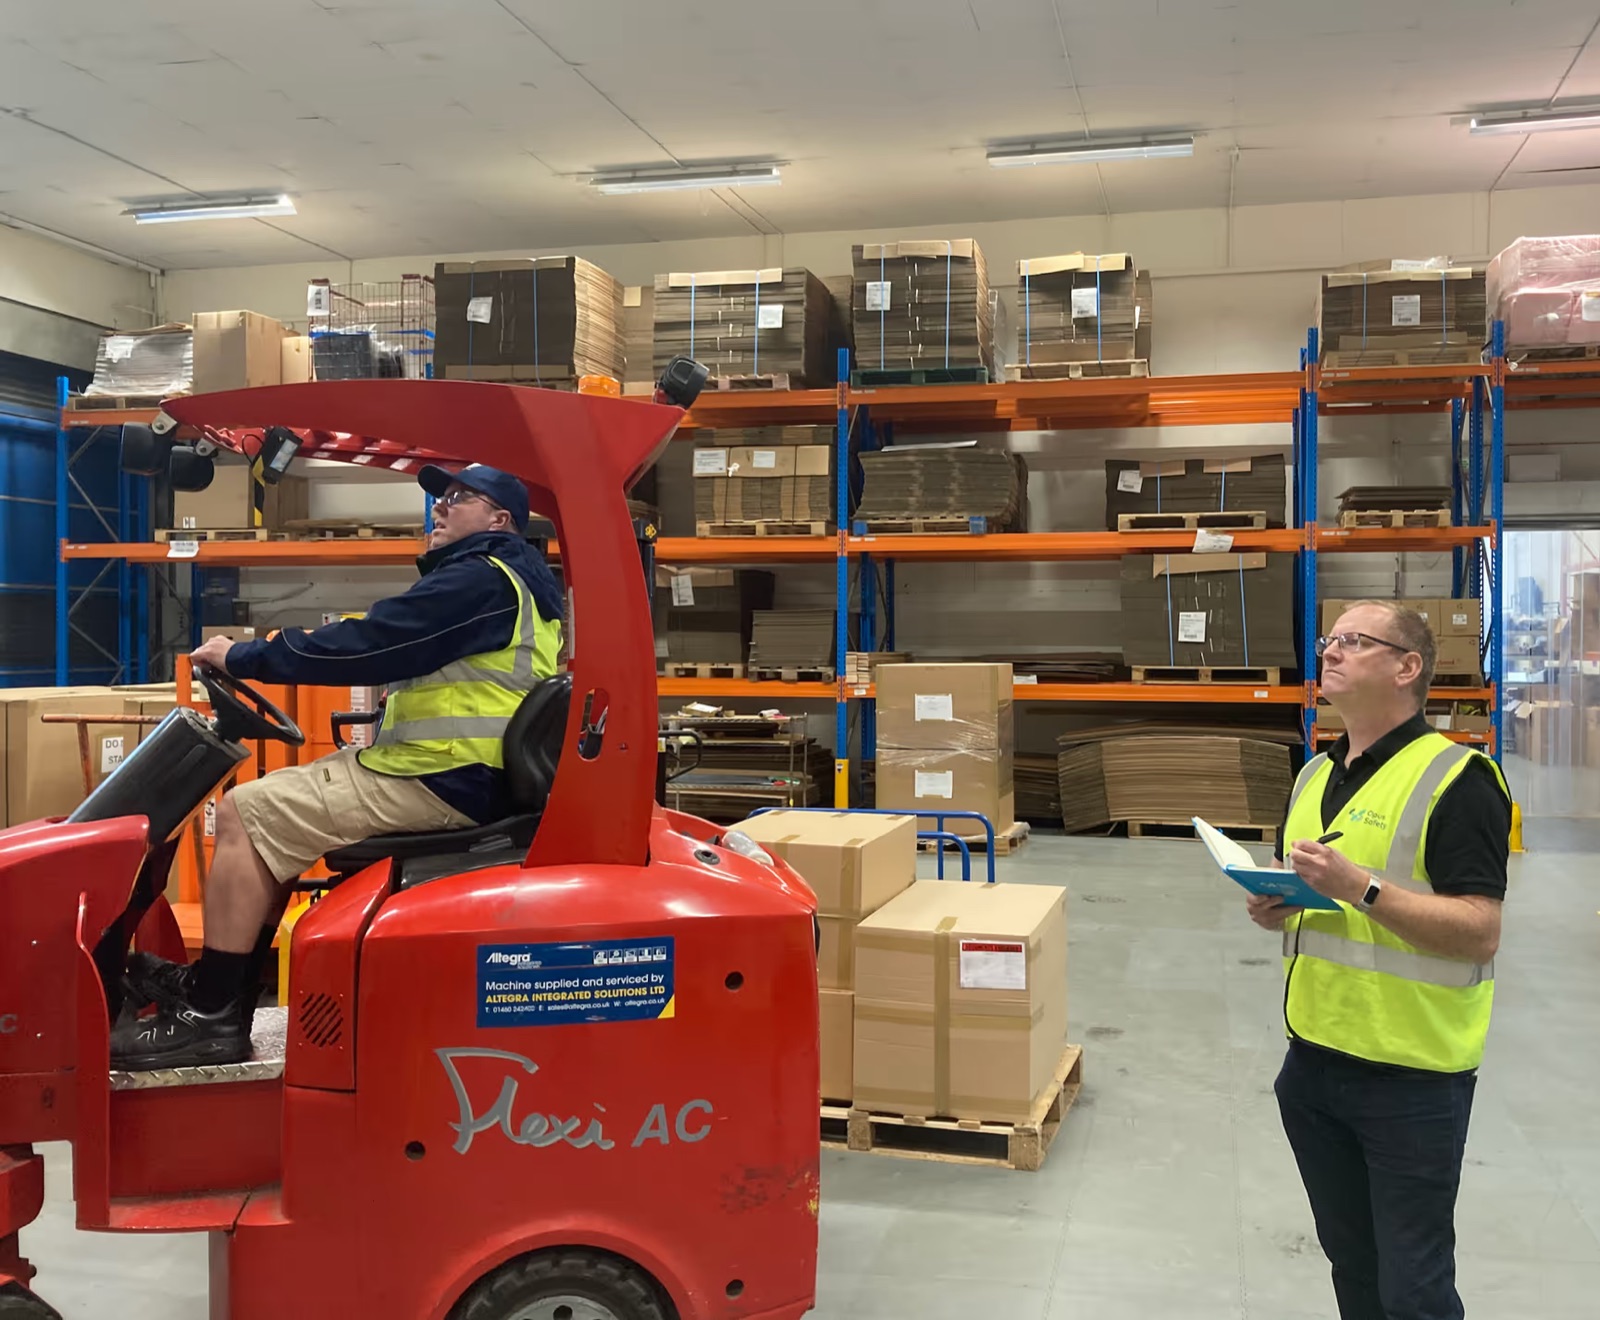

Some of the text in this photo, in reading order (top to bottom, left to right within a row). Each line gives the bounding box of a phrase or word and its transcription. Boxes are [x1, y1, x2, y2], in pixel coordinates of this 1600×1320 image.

[105, 739, 119, 749] DO
[1363, 817, 1386, 830] Safety
[485, 972, 664, 991] Machine supplied and serviced by
[486, 985, 665, 1003] ALTEGRA INTEGRATED SOLUTIONS LTD
[434, 1046, 713, 1155] Flexi AC
